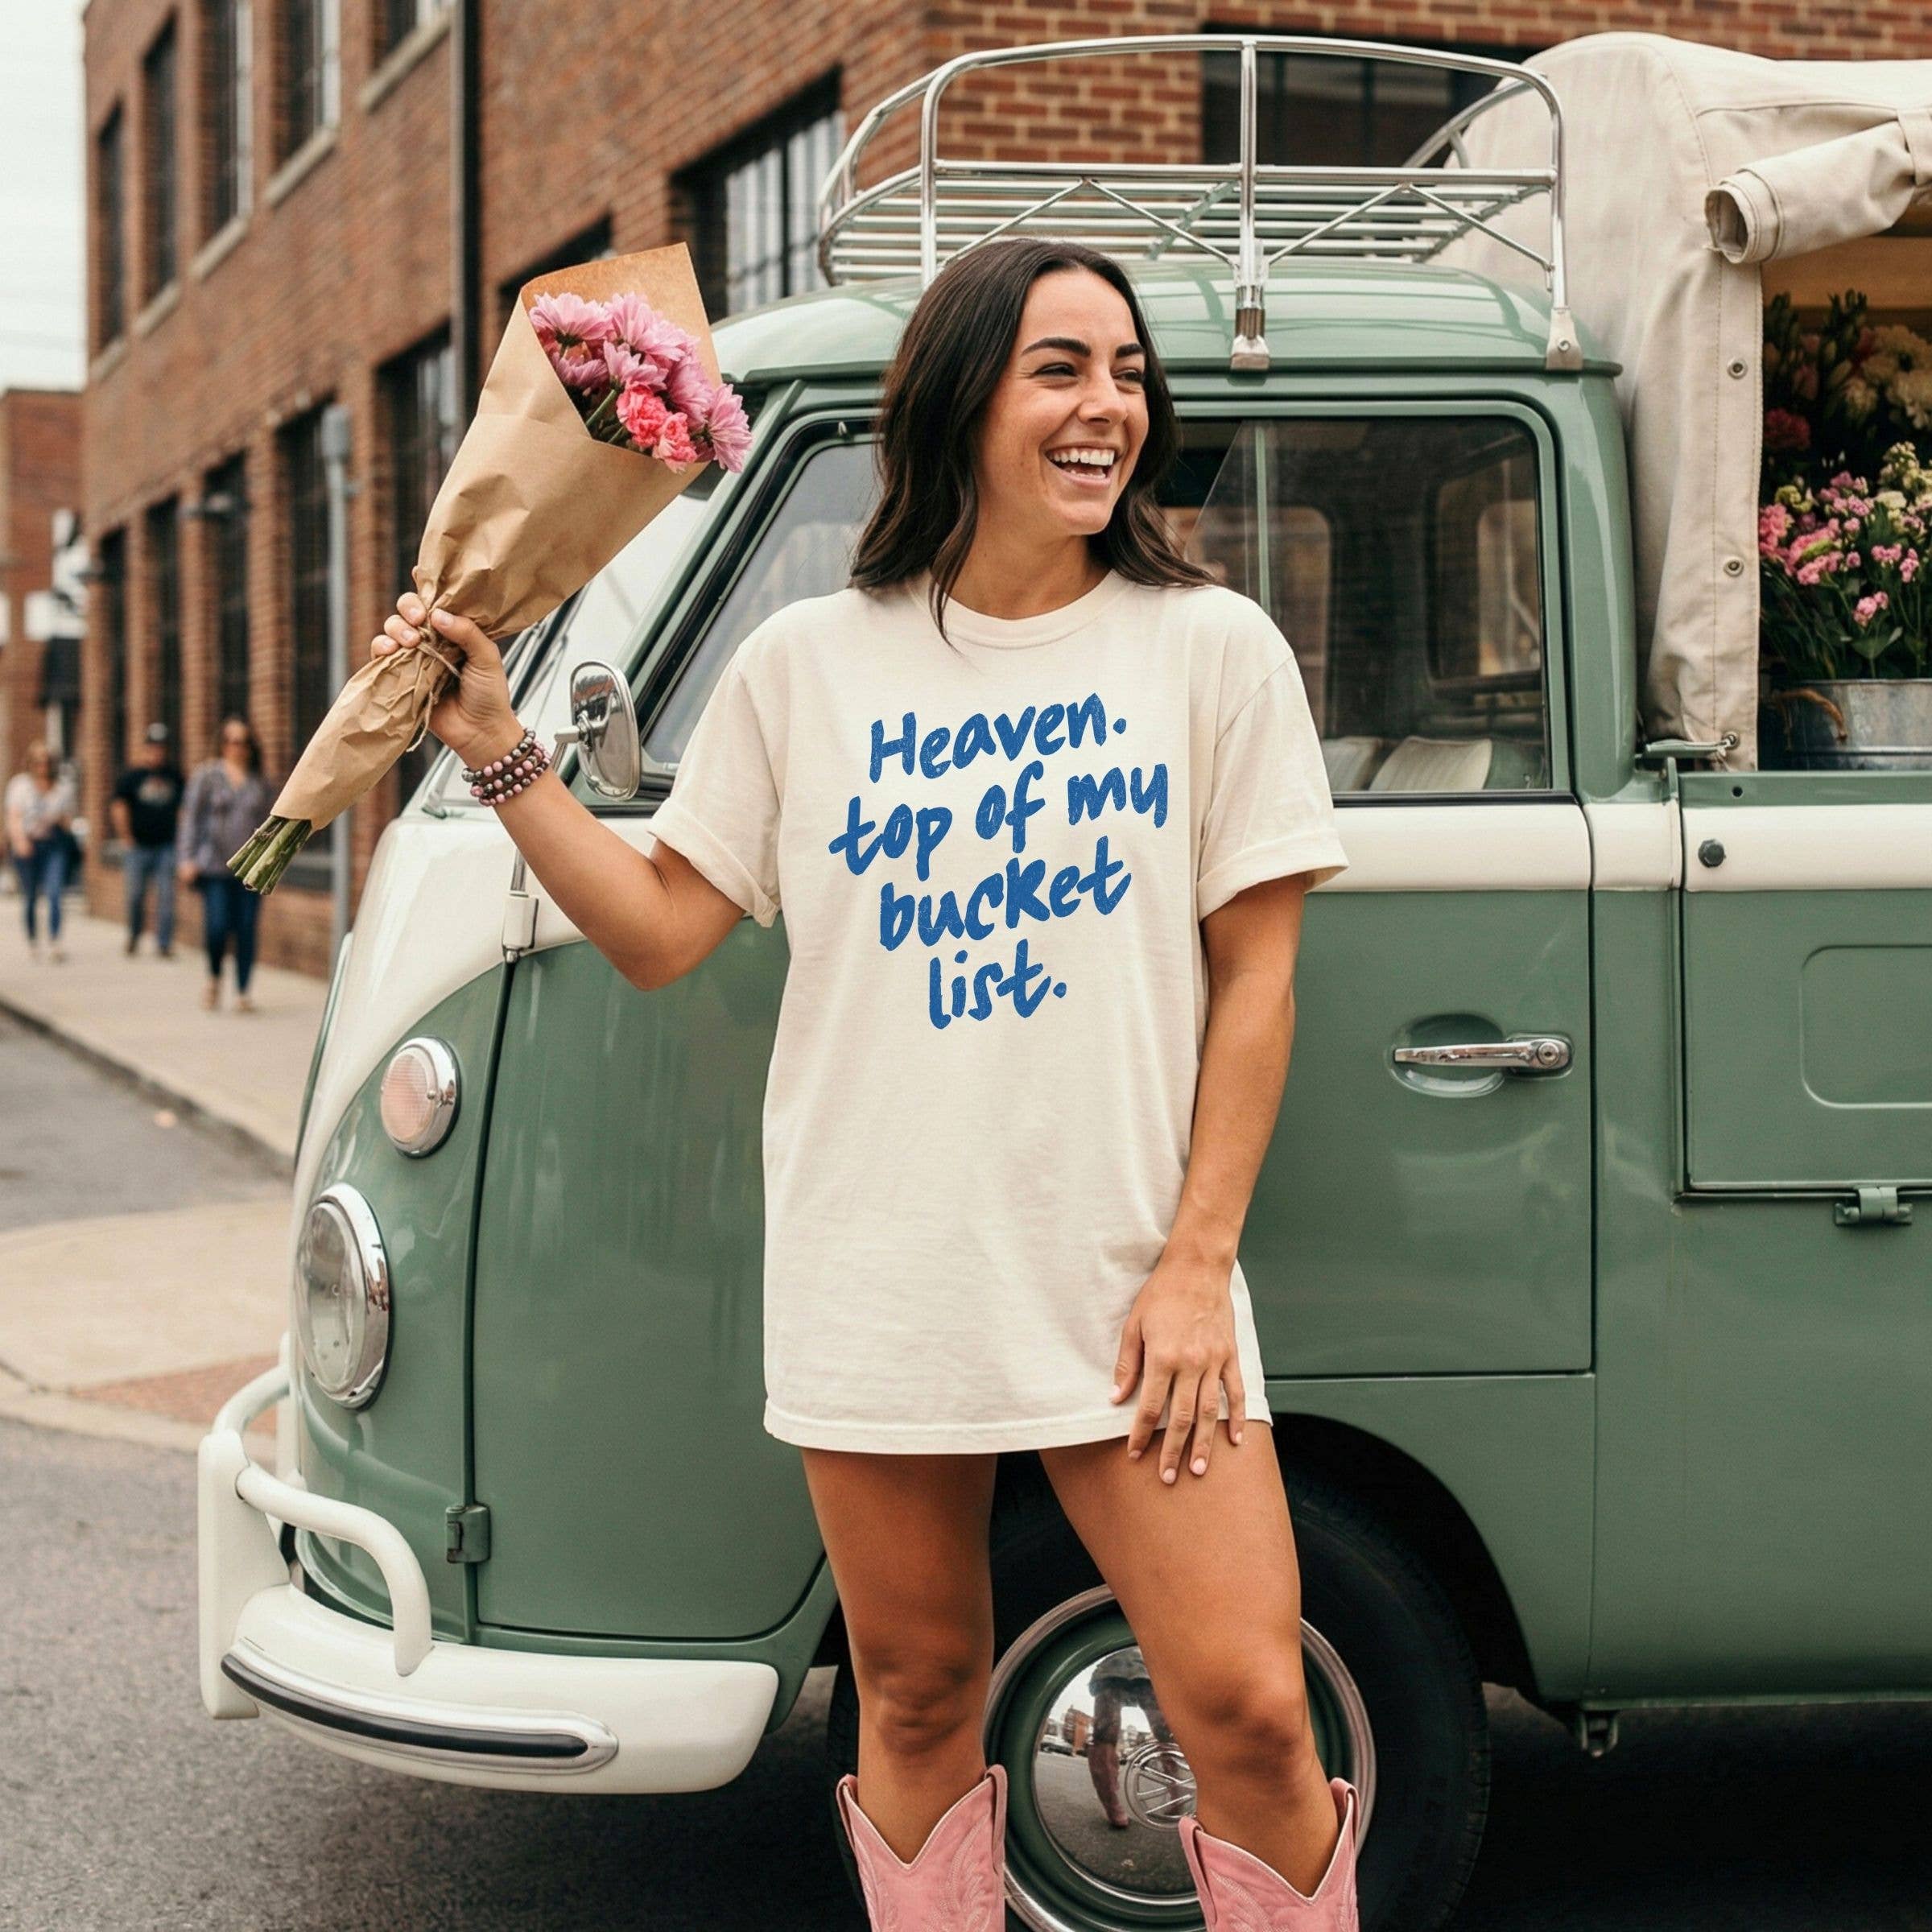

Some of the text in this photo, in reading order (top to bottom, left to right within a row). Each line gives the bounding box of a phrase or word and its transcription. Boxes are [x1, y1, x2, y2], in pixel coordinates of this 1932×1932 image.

[869, 693, 1127, 783] Heaven.
[828, 760, 1169, 881] top of my
[928, 939, 1067, 1030] list.
